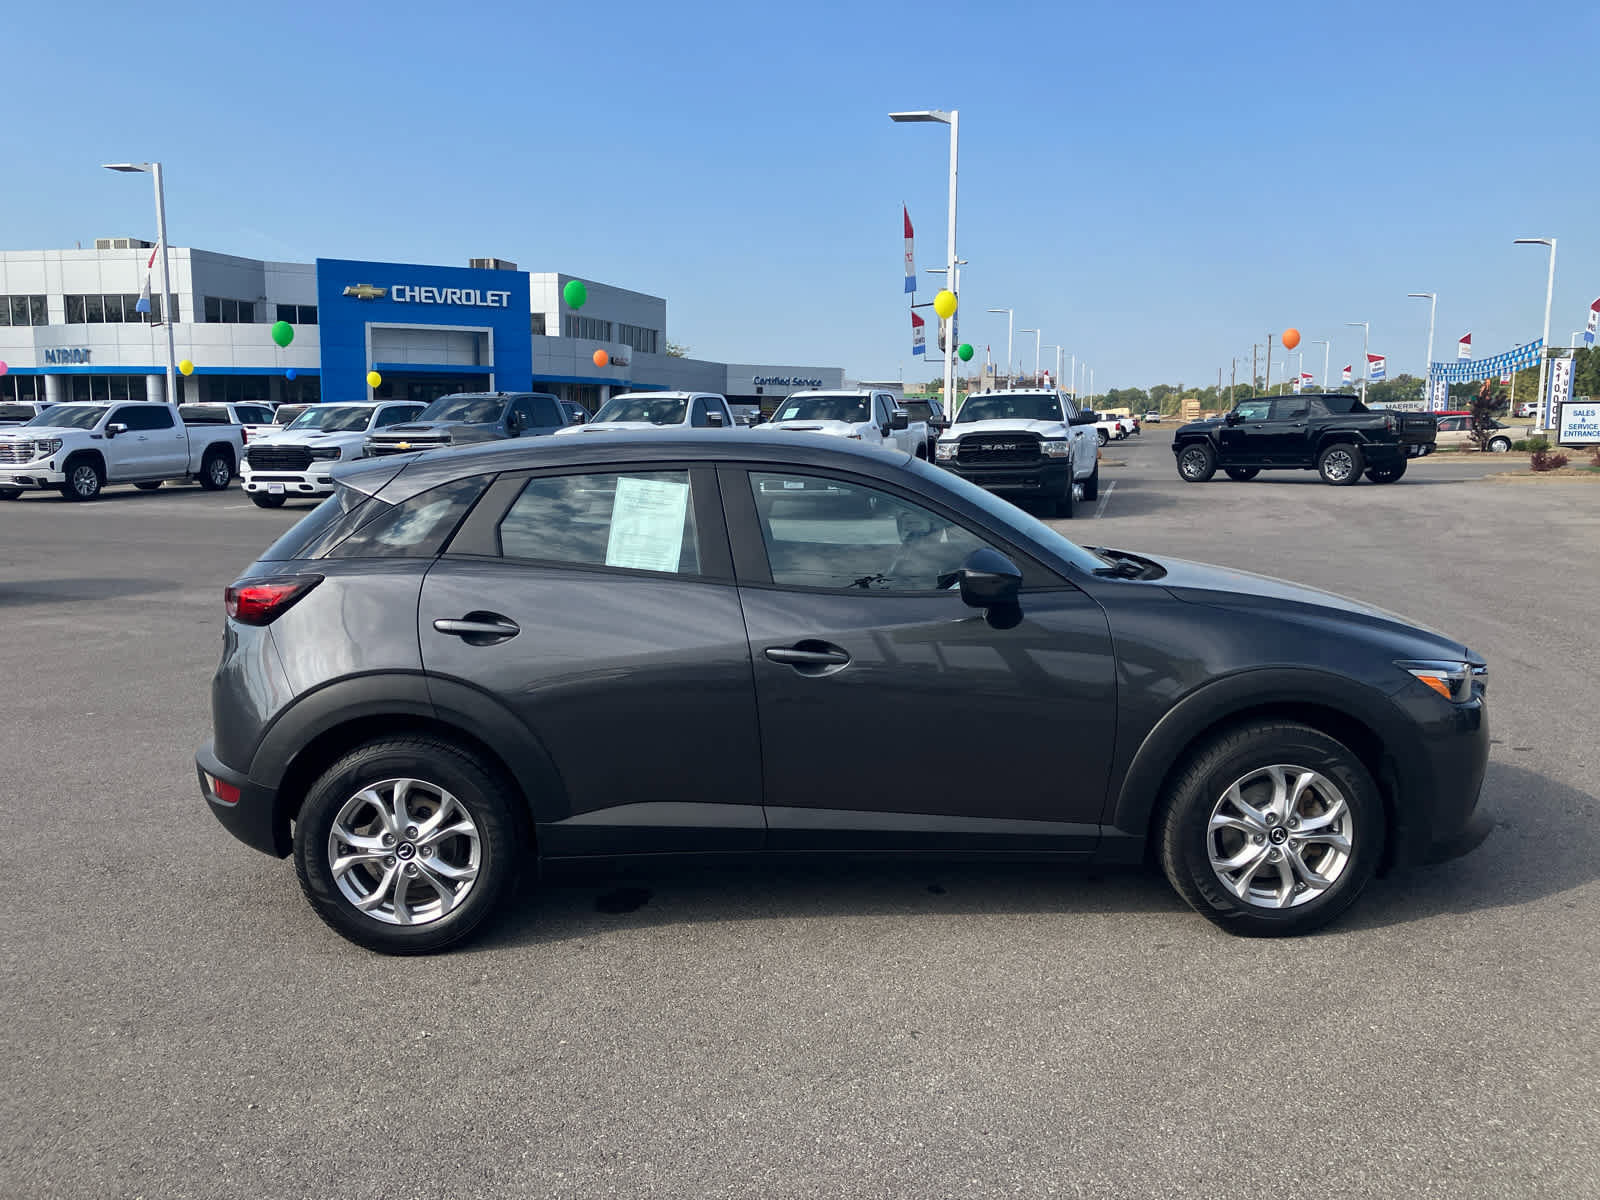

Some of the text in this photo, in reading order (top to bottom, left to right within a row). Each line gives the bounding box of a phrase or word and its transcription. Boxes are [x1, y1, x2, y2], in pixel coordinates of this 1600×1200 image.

[391, 285, 511, 307] CHEVROLET
[754, 376, 822, 387] Certified Service
